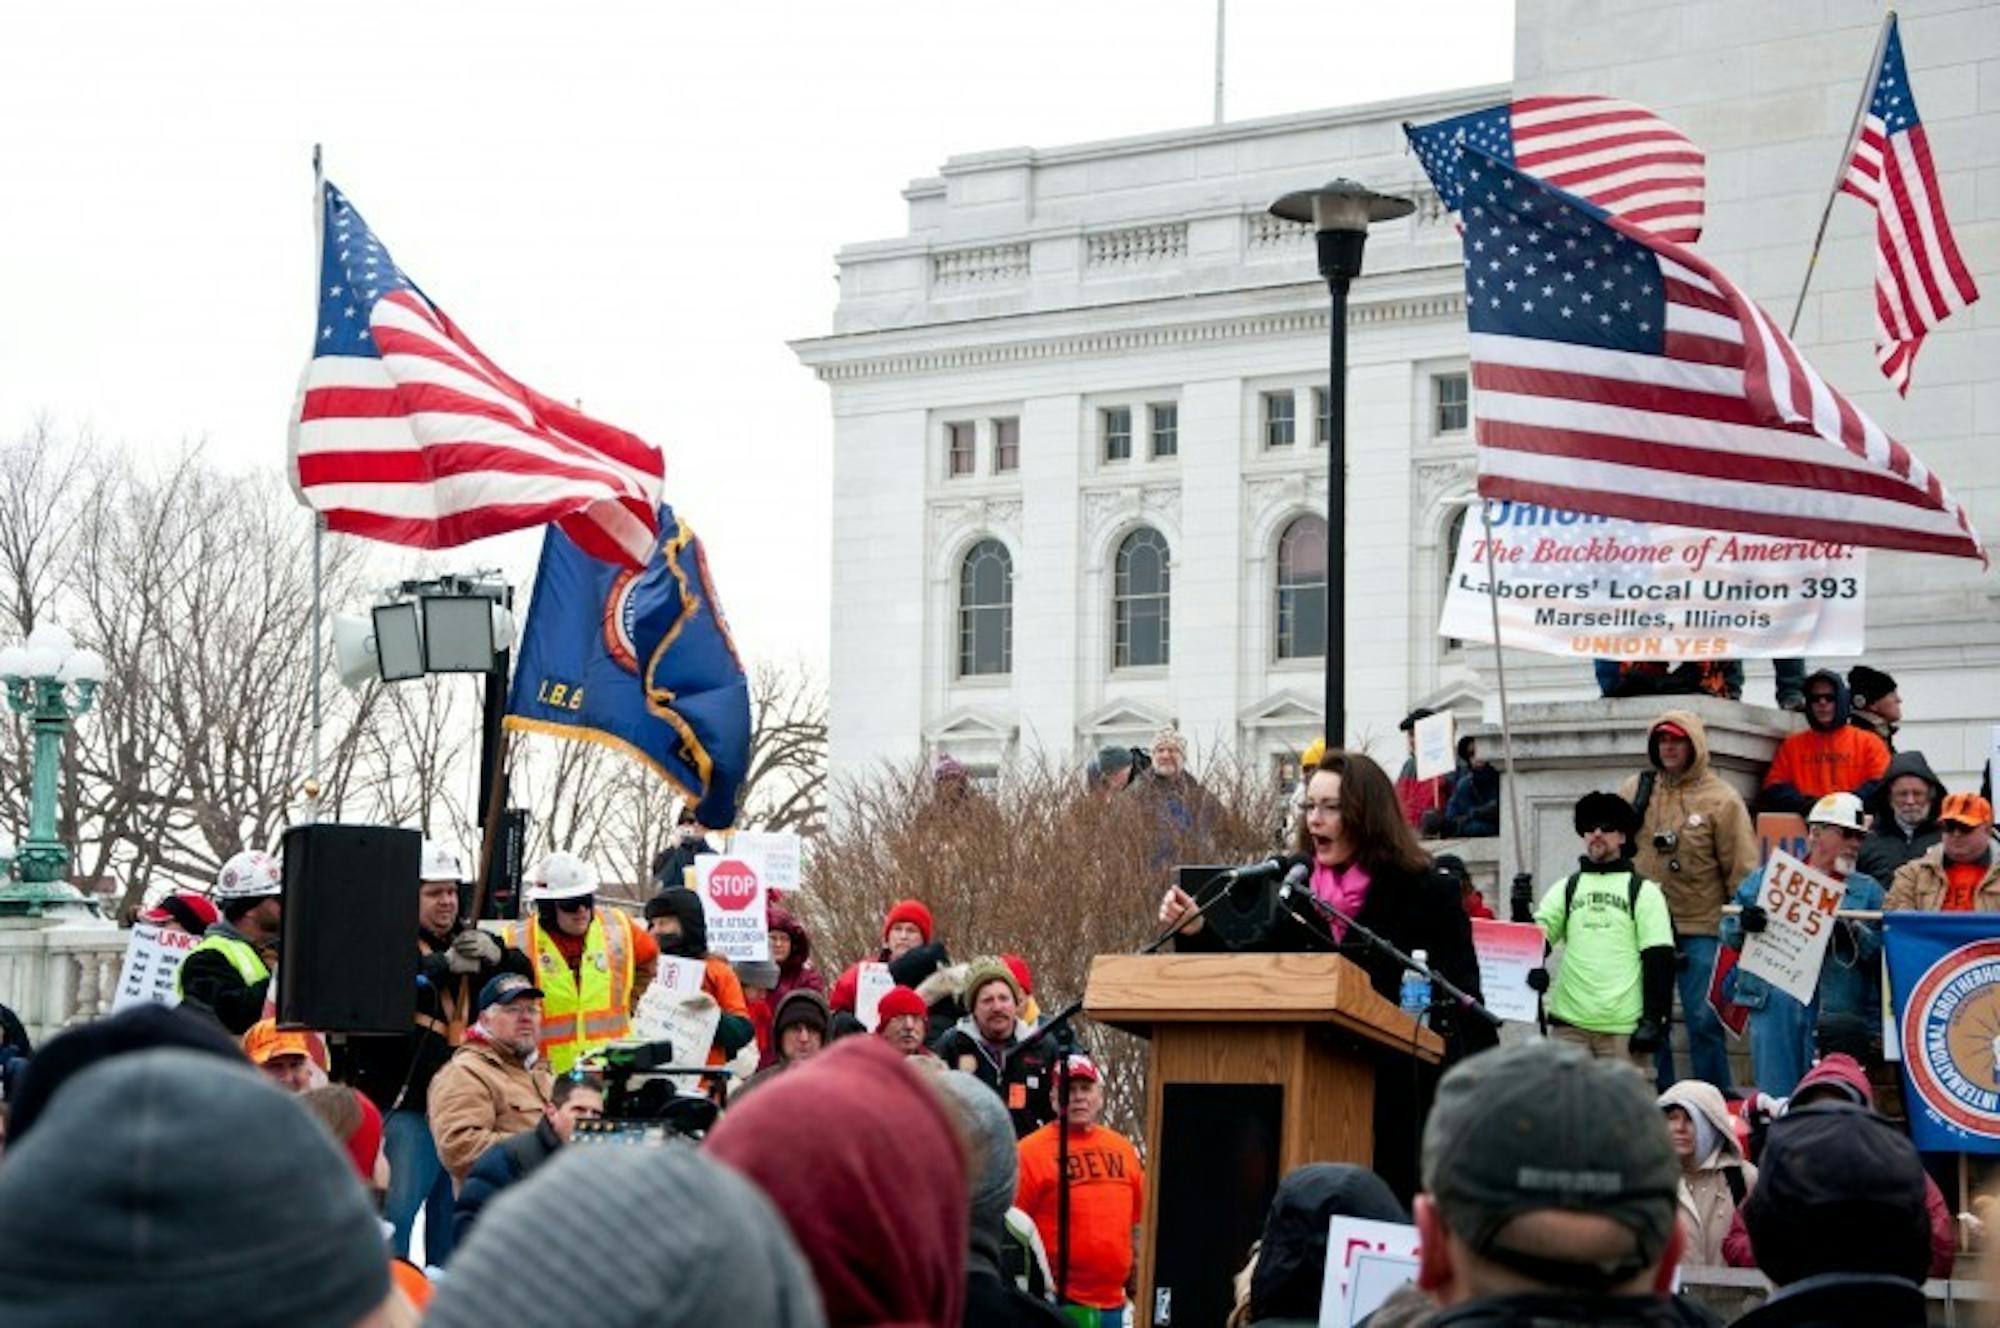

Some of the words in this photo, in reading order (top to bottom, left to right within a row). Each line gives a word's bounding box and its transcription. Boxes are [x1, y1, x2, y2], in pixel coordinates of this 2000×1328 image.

[1471, 537, 1525, 564] The
[1531, 535, 1672, 565] Backbone
[1682, 536, 1718, 573] of
[1609, 579, 1692, 600] Local
[1703, 579, 1790, 600] Union
[1800, 577, 1858, 599] 393
[1534, 607, 1675, 631] Marseilles,
[1684, 609, 1771, 629] Illinois
[1571, 635, 1662, 655] UNION
[1674, 637, 1729, 654] YES
[711, 874, 754, 897] STOP
[1767, 889, 1822, 936] 965
[1056, 1151, 1126, 1180] BEW
